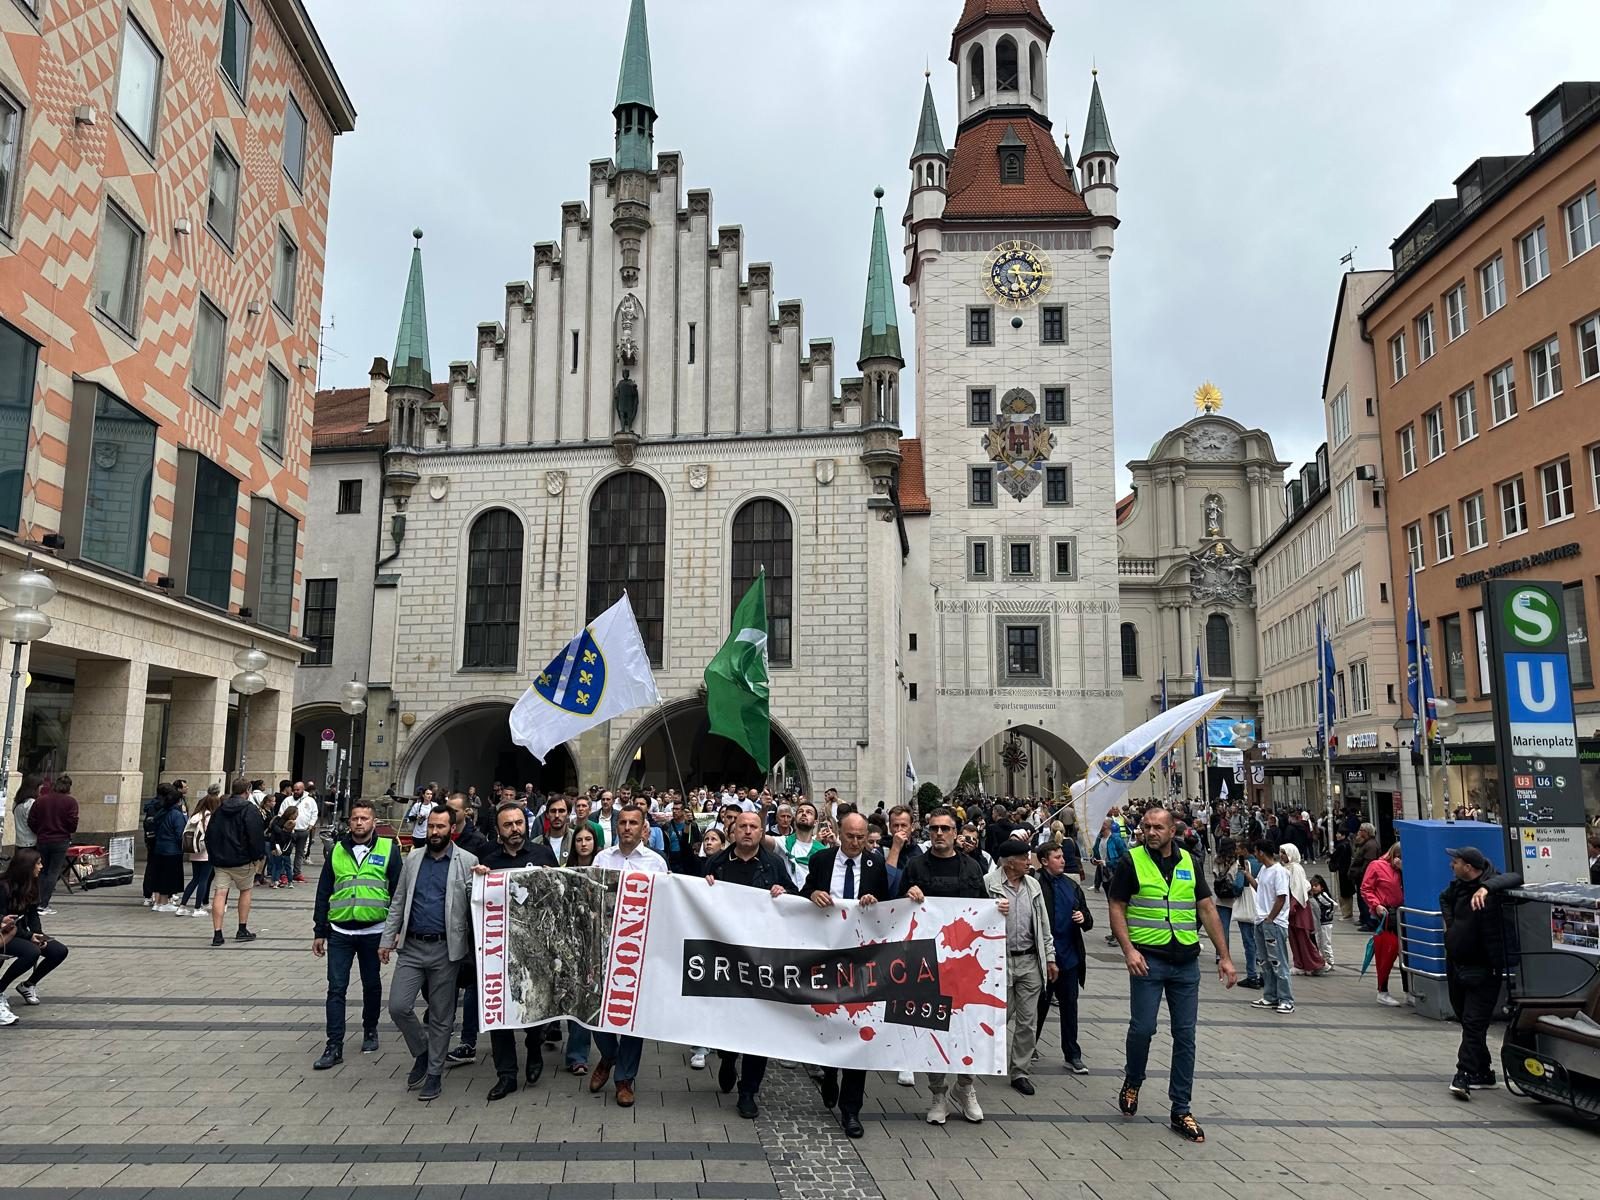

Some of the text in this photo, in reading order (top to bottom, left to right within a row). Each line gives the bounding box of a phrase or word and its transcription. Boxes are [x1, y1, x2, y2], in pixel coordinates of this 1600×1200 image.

[1512, 590, 1553, 643] S
[1516, 661, 1556, 713] U
[1512, 735, 1574, 749] Marienplatz
[1517, 775, 1566, 788] U3 U6 S
[1525, 848, 1536, 857] WC
[485, 901, 504, 959] JULY
[607, 872, 650, 1027] GENOCID
[687, 955, 936, 990] SREBRENICA
[484, 972, 503, 1025] 1995
[890, 999, 948, 1021] 1995
